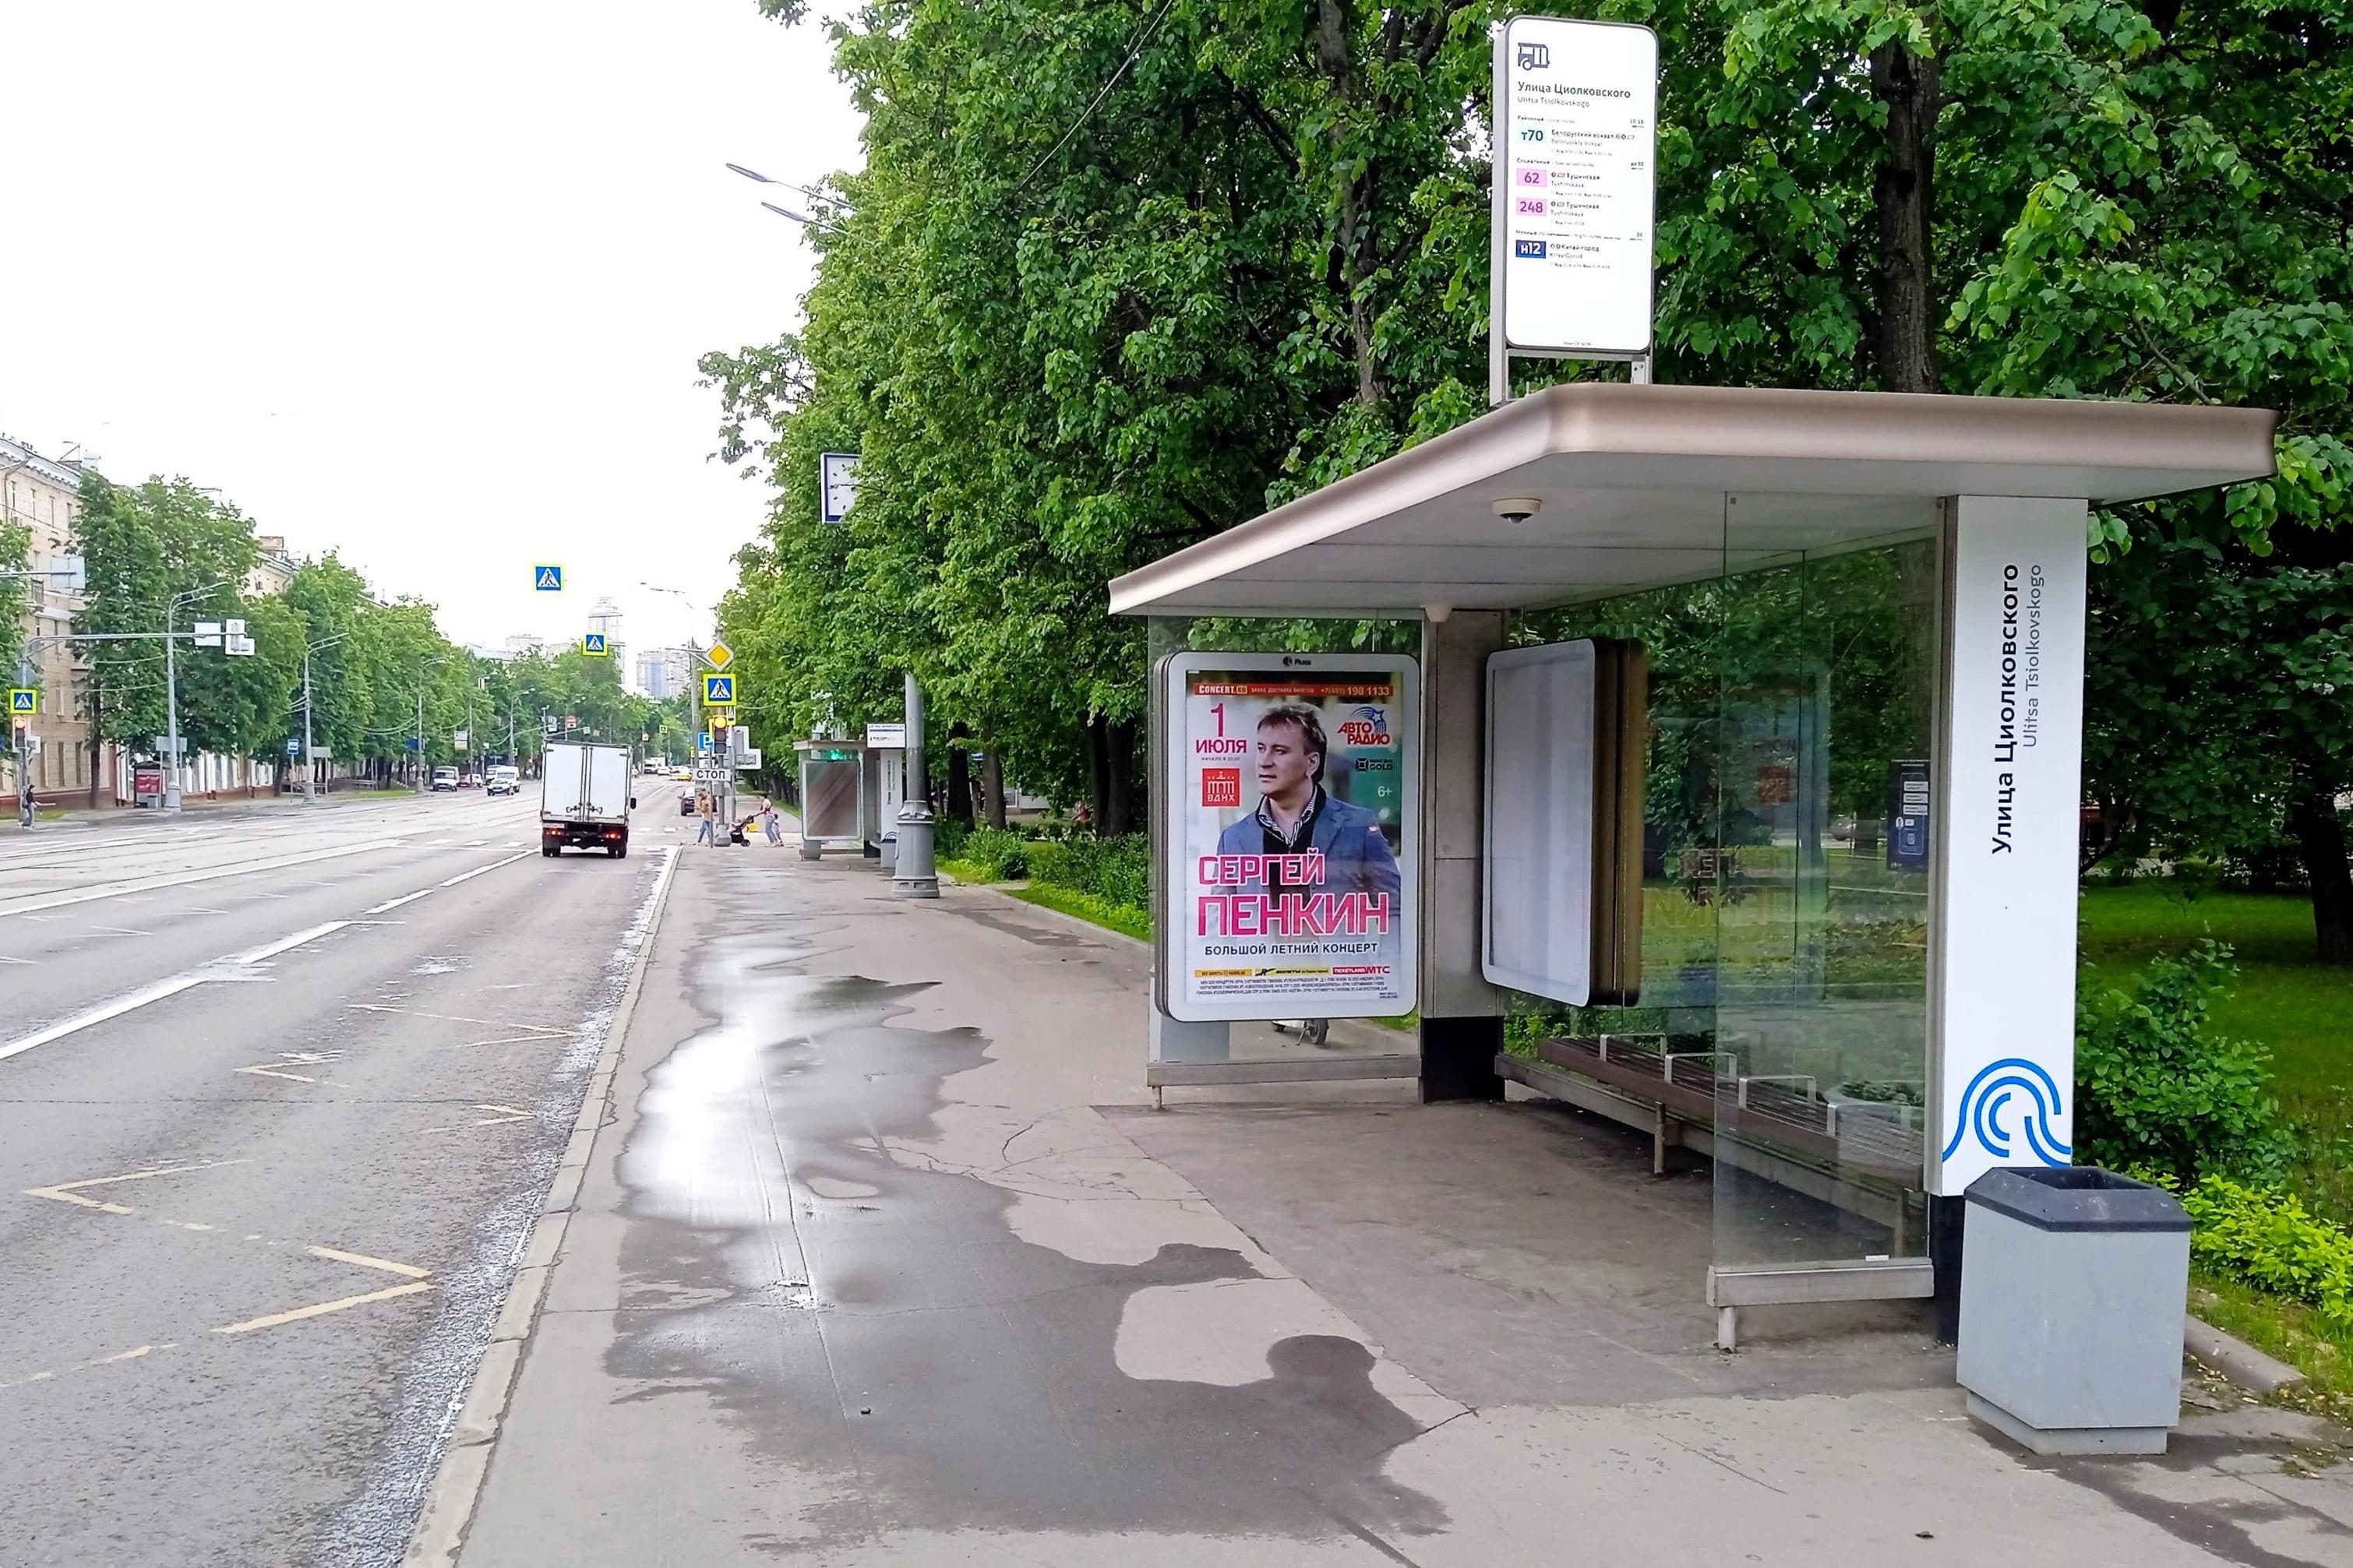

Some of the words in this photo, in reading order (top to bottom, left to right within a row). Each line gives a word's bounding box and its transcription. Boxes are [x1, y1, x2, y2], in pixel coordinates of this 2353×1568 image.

[1517, 81, 1551, 93] Улица
[1554, 83, 1631, 98] Циолковского
[1524, 171, 1540, 184] 62
[1519, 201, 1543, 213] 248
[2025, 564, 2044, 692] Tsiolkovskogo
[1994, 564, 2020, 763] Циолковского
[1347, 686, 1363, 695] 198
[1367, 686, 1390, 696] 1133
[1211, 703, 1224, 737] 1
[2023, 697, 2040, 748] Ulitsa
[1337, 721, 1373, 734] АВТО
[1196, 739, 1247, 753] ИЮЛЯ
[1347, 734, 1391, 745] РАДИО
[697, 770, 725, 780] СТОП
[1207, 794, 1235, 802] ВДНХ
[1378, 786, 1392, 797] 6+
[1991, 771, 2016, 854] Улица
[1198, 847, 1325, 886] СЕРГЕЙ
[1198, 893, 1389, 937] ПЕНКИН
[1205, 943, 1265, 956] БОЛЬШОЙ
[1271, 943, 1319, 955] ЛЕТНИЙ
[1323, 942, 1378, 955] КОНЦЕРТ
